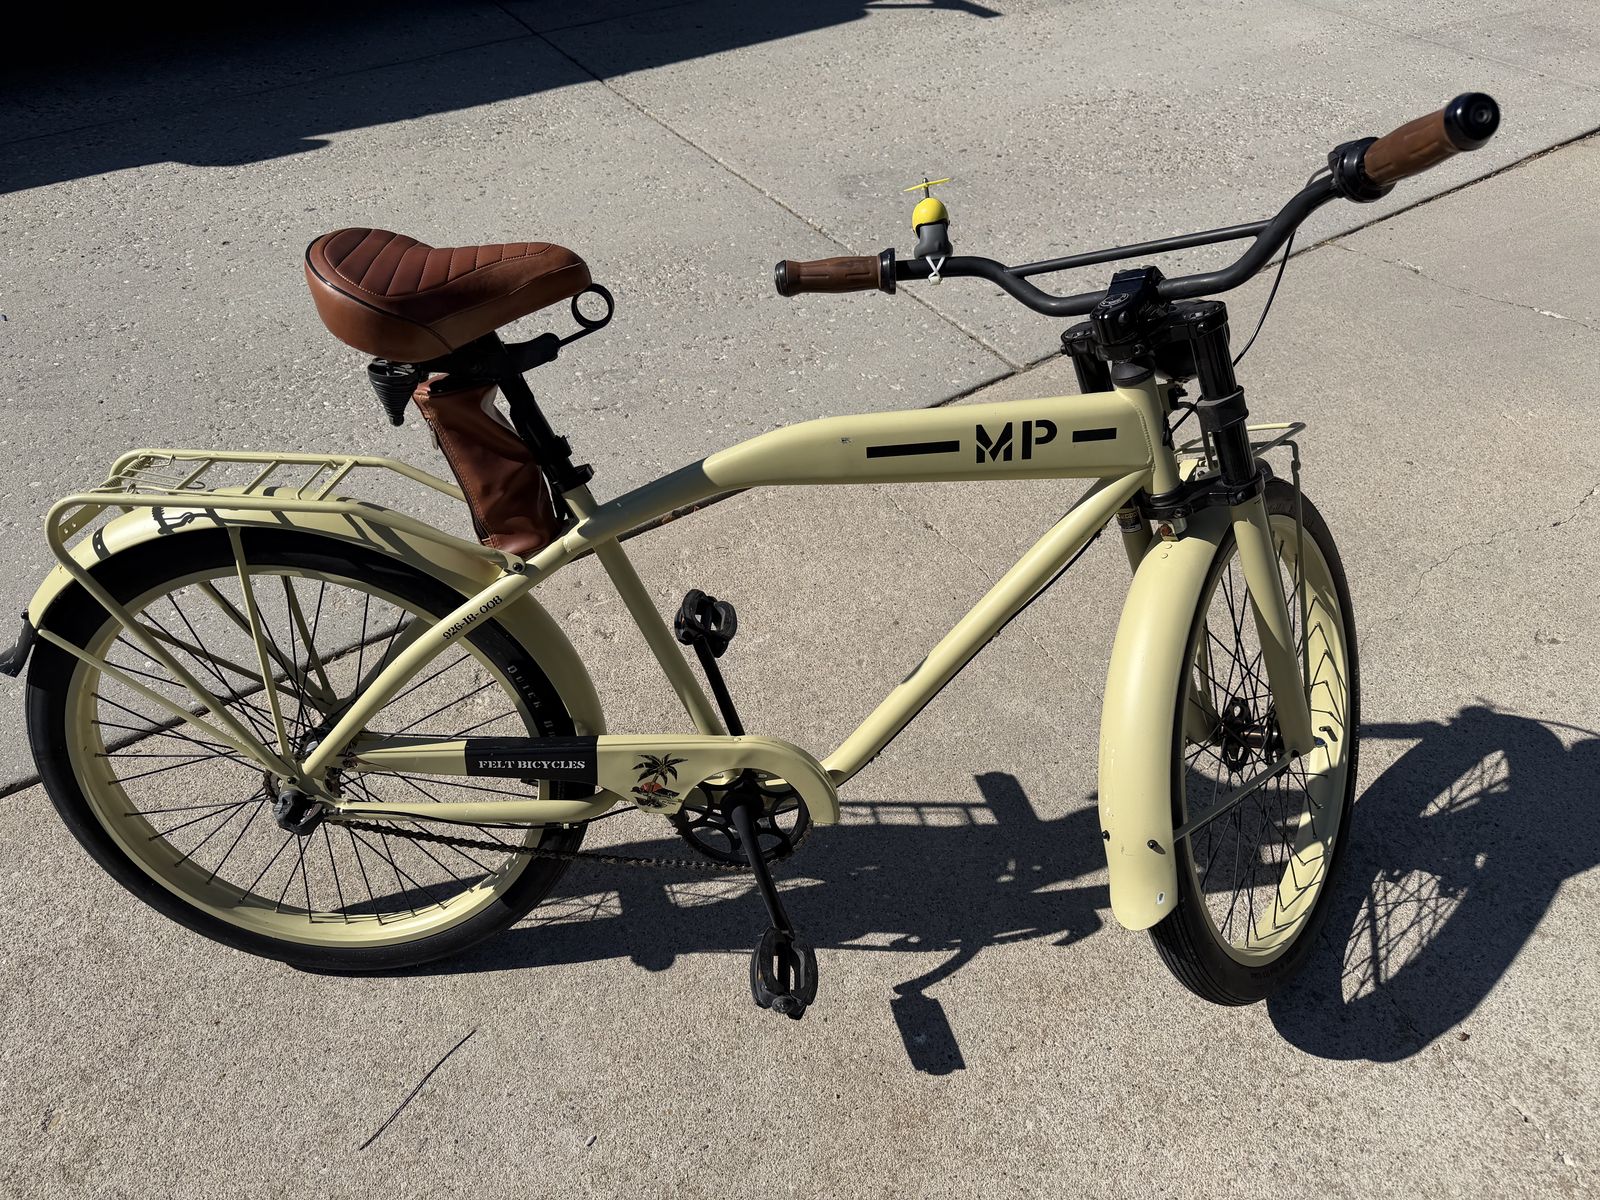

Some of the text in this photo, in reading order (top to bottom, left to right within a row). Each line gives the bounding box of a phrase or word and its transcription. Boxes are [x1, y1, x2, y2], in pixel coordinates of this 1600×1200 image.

[976, 419, 1058, 463] MP
[478, 760, 586, 769] FELT BICYCLES
